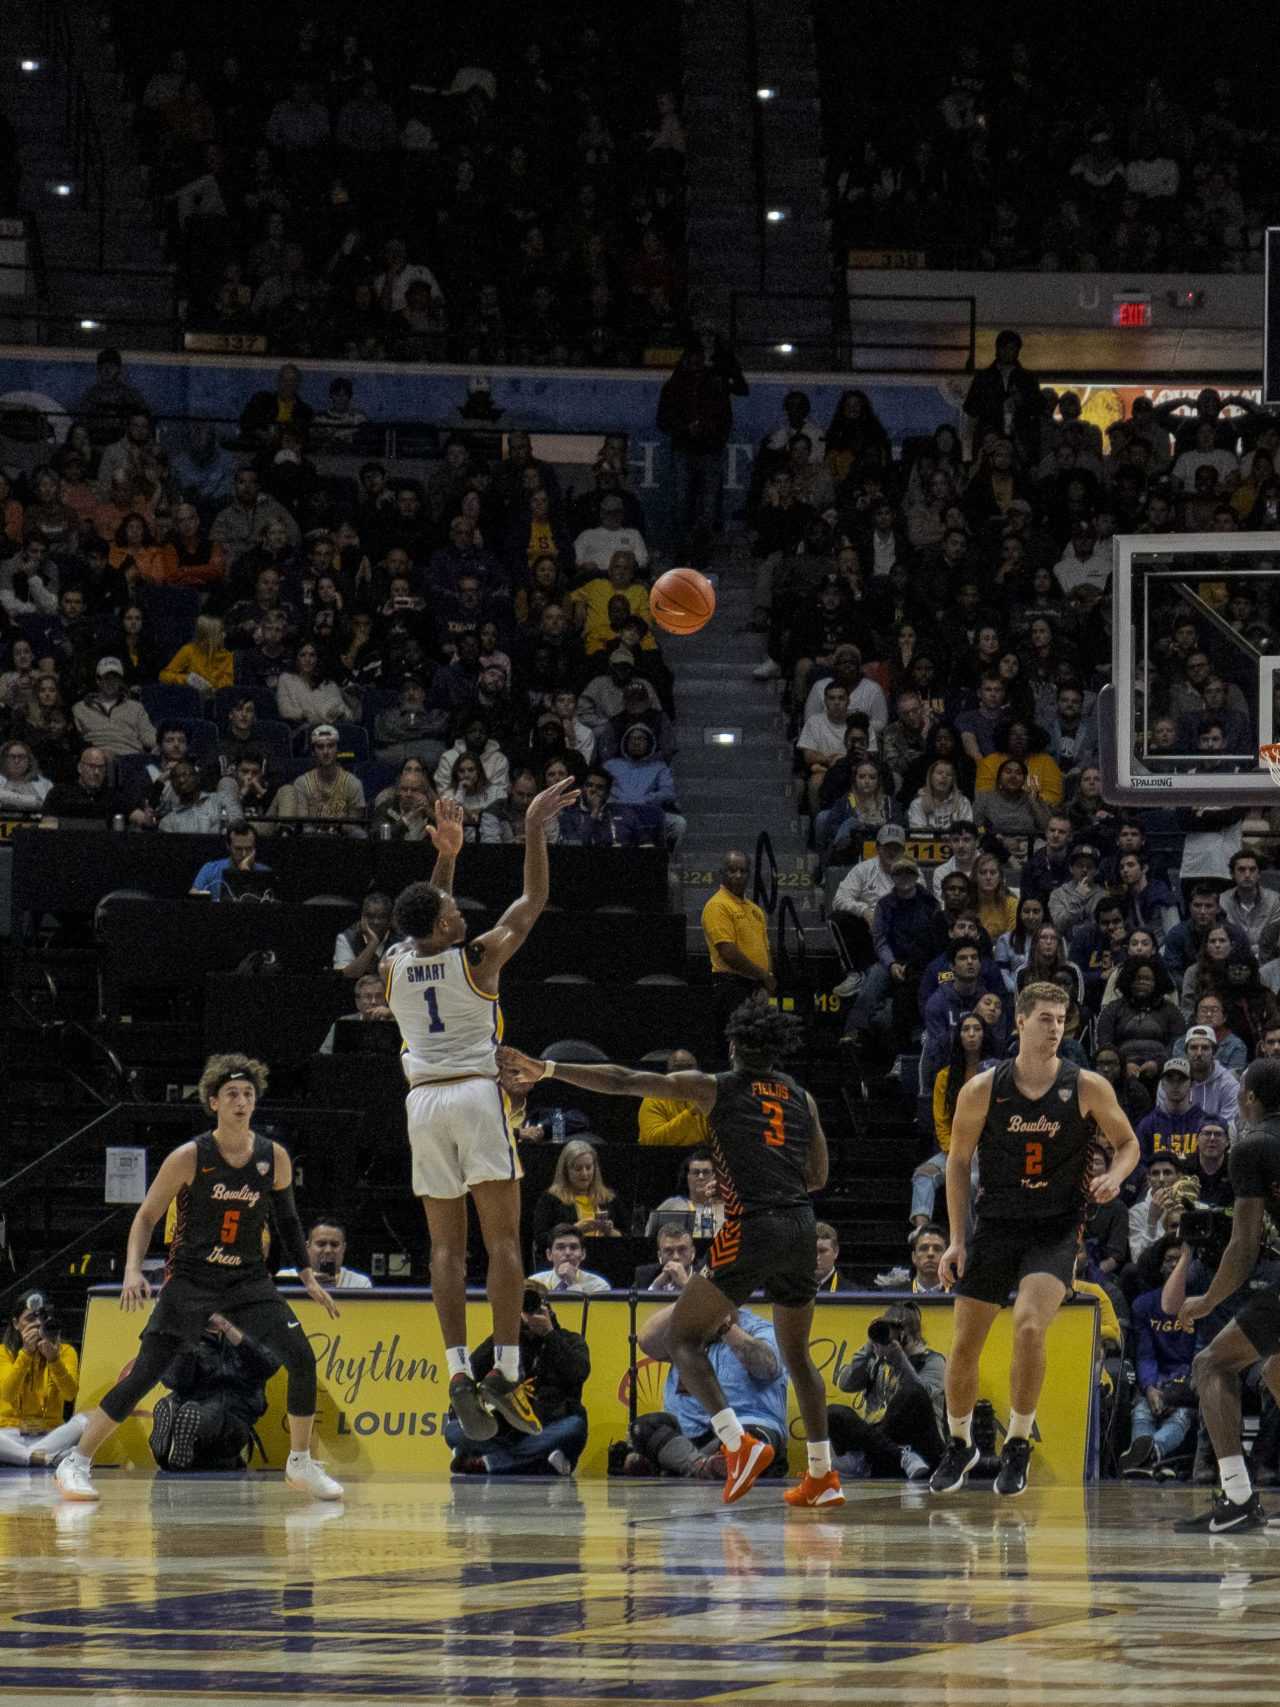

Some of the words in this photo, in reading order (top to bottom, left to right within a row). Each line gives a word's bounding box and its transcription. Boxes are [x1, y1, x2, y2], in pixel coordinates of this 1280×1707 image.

[1119, 303, 1146, 327] EXIT
[1130, 777, 1173, 788] SPALDING
[908, 843, 953, 862] 119
[776, 872, 811, 887] 225
[407, 963, 445, 982] SMART
[424, 987, 445, 1034] 1
[761, 1101, 785, 1147] 3
[1007, 1114, 1061, 1138] Bowling
[1153, 1132, 1200, 1153] LSU
[1024, 1143, 1042, 1175] 2
[211, 1183, 260, 1208] Bowling
[221, 1209, 241, 1246] 5
[206, 1246, 242, 1265] Green
[1150, 1317, 1195, 1335] TIGES
